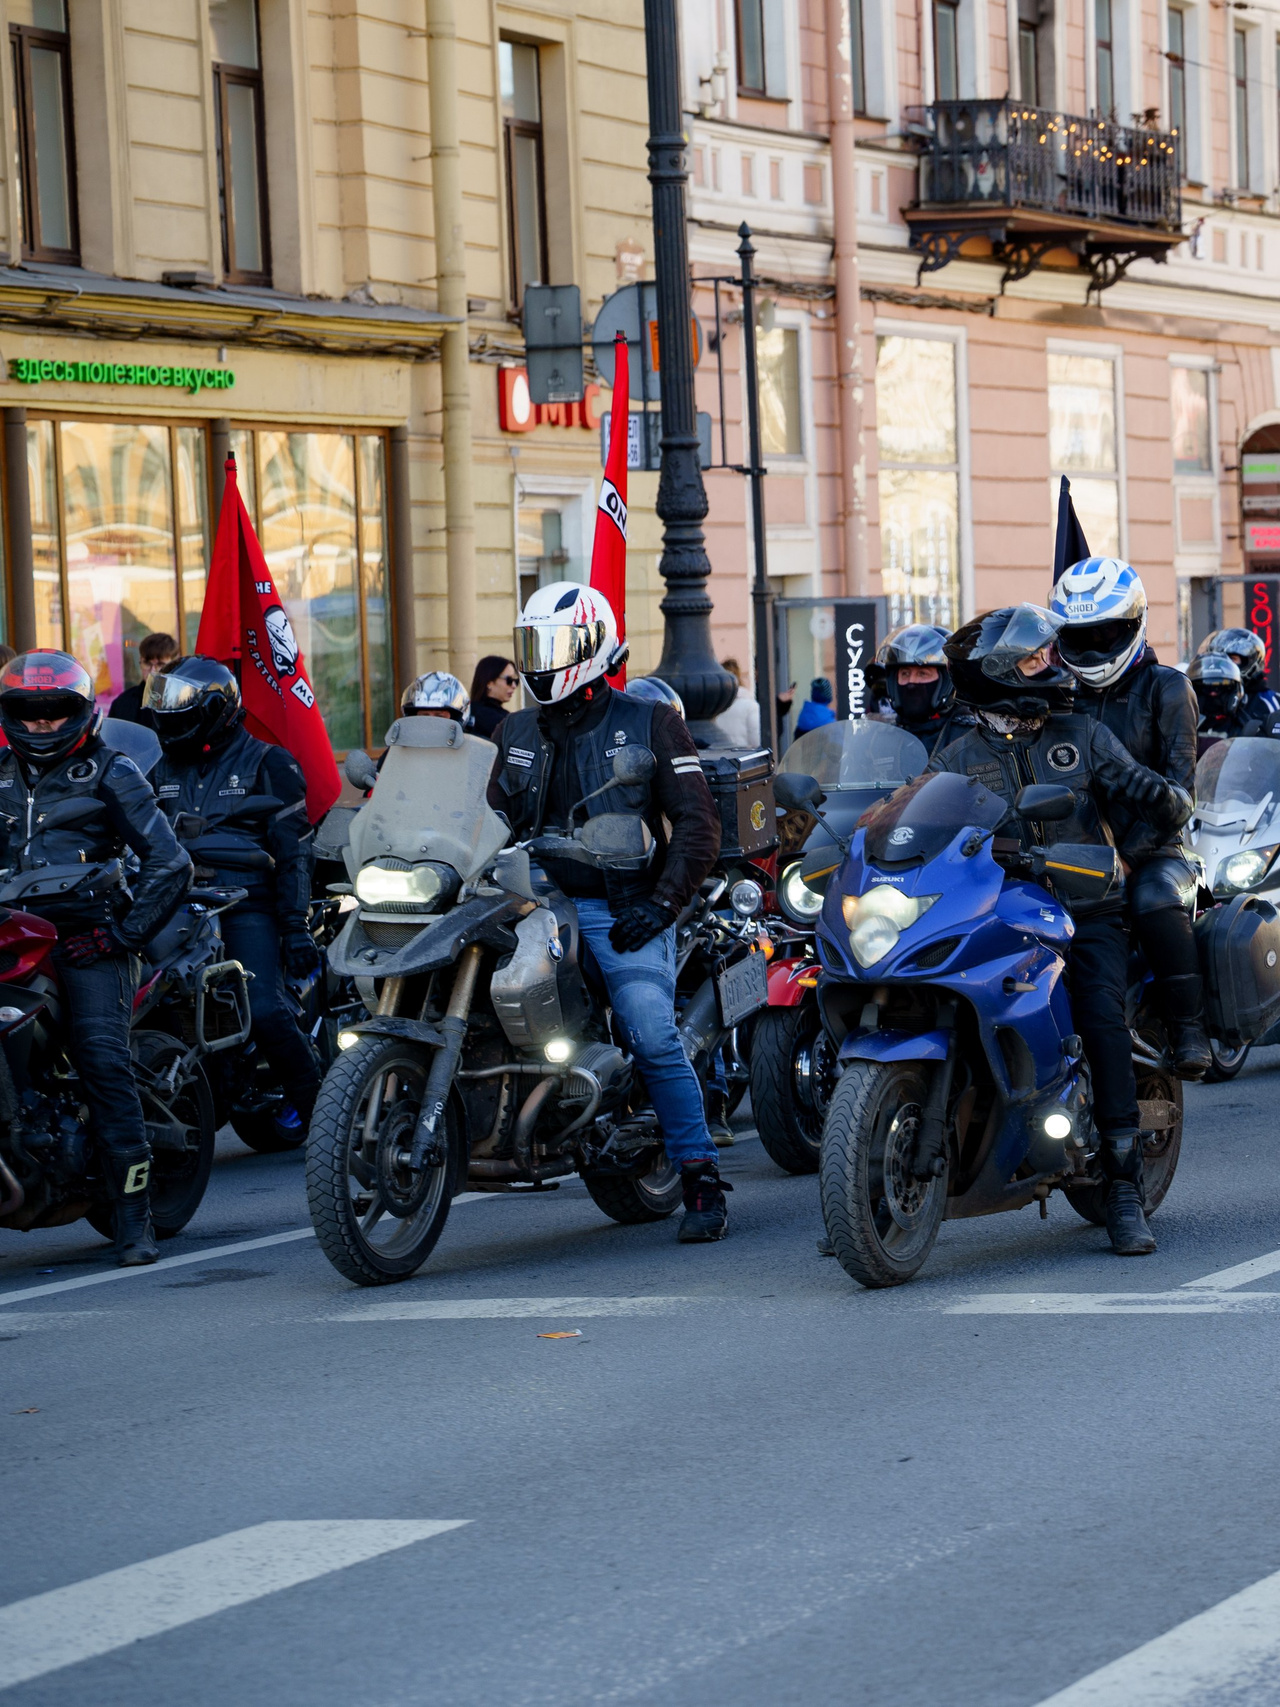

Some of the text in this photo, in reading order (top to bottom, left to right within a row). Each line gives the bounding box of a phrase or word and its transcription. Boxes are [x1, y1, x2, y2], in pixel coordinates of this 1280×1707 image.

[17, 358, 236, 395] здесь полезное вкусно
[1068, 603, 1094, 613] SHOEI
[25, 675, 53, 686] SHOEI
